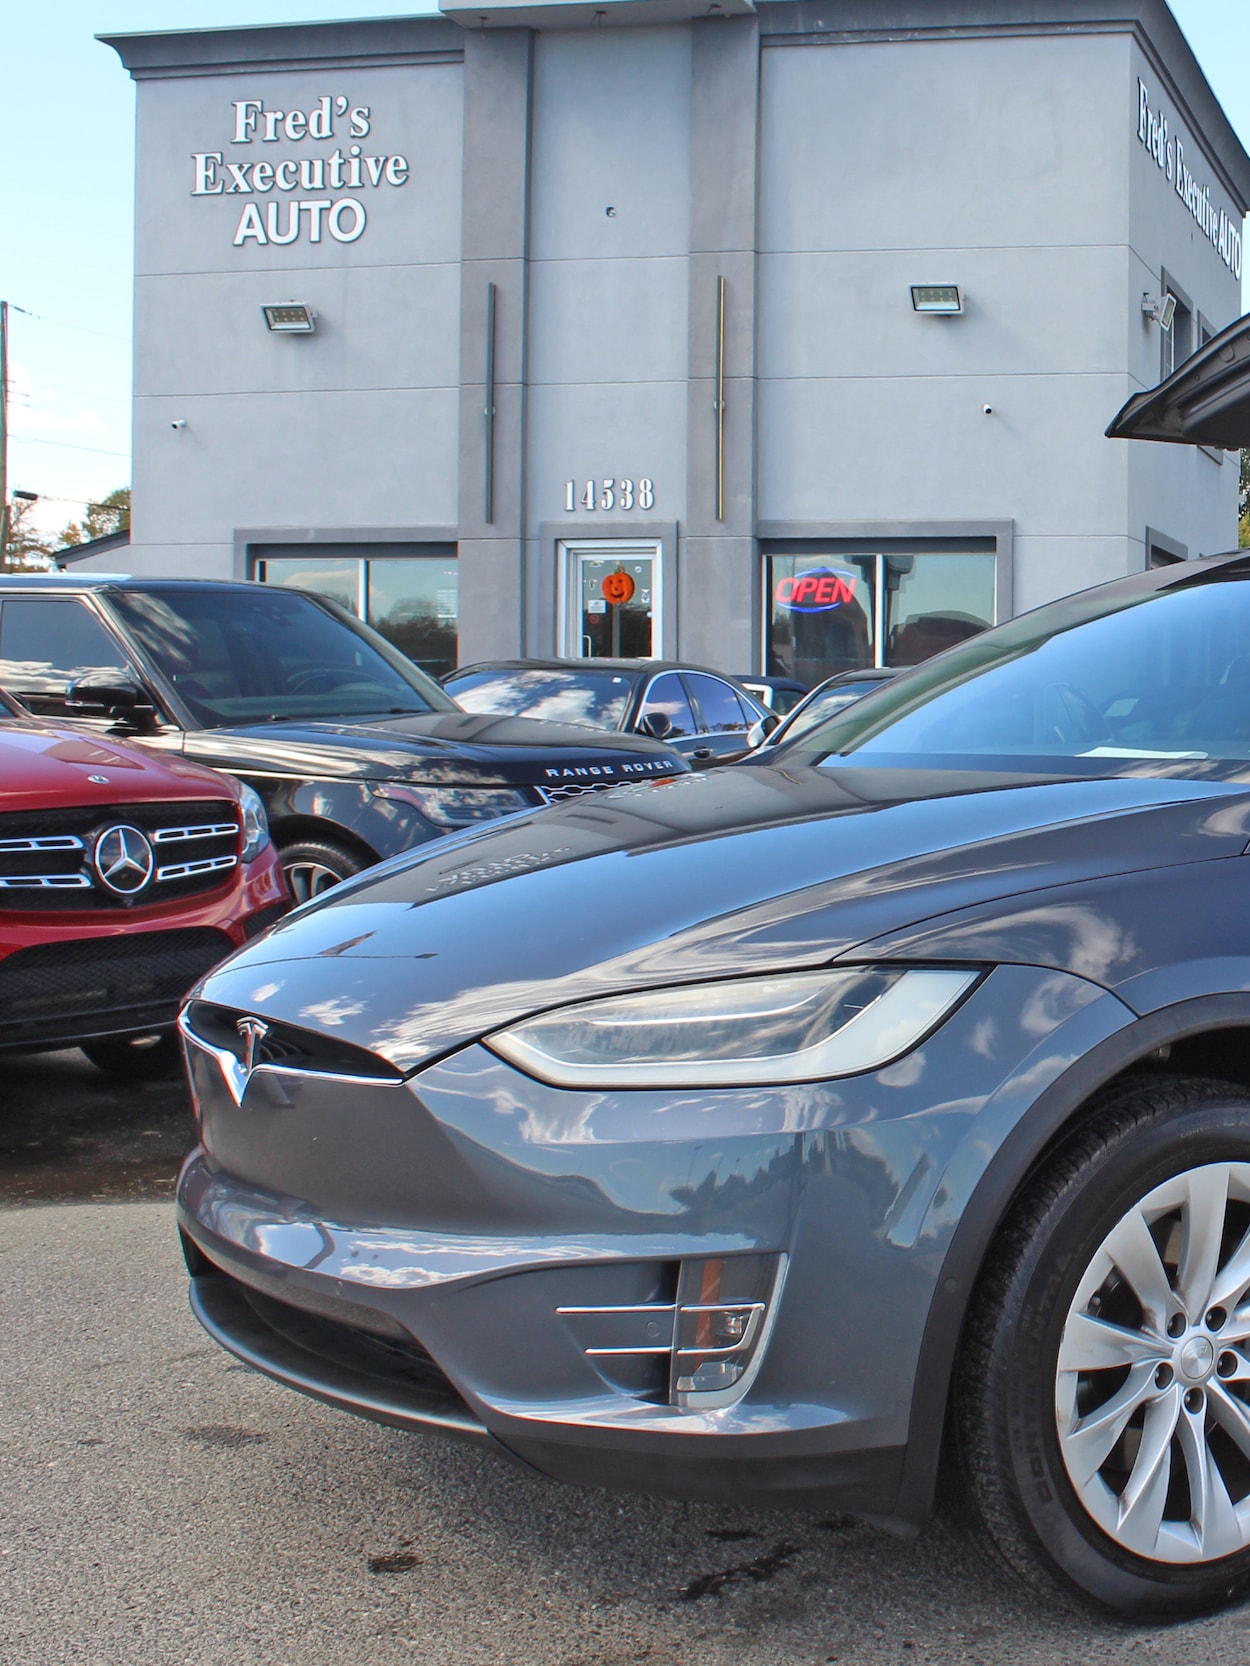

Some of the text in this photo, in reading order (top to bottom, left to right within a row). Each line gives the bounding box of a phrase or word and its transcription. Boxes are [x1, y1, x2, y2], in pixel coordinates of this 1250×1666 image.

[231, 95, 371, 144] Fred's
[190, 145, 410, 196] Executive
[1137, 77, 1243, 281] Fred's Executive AUTO
[232, 197, 367, 246] AUTO
[564, 478, 655, 512] 14538
[775, 577, 857, 604] OPEN
[545, 760, 673, 778] RANGE ROVER
